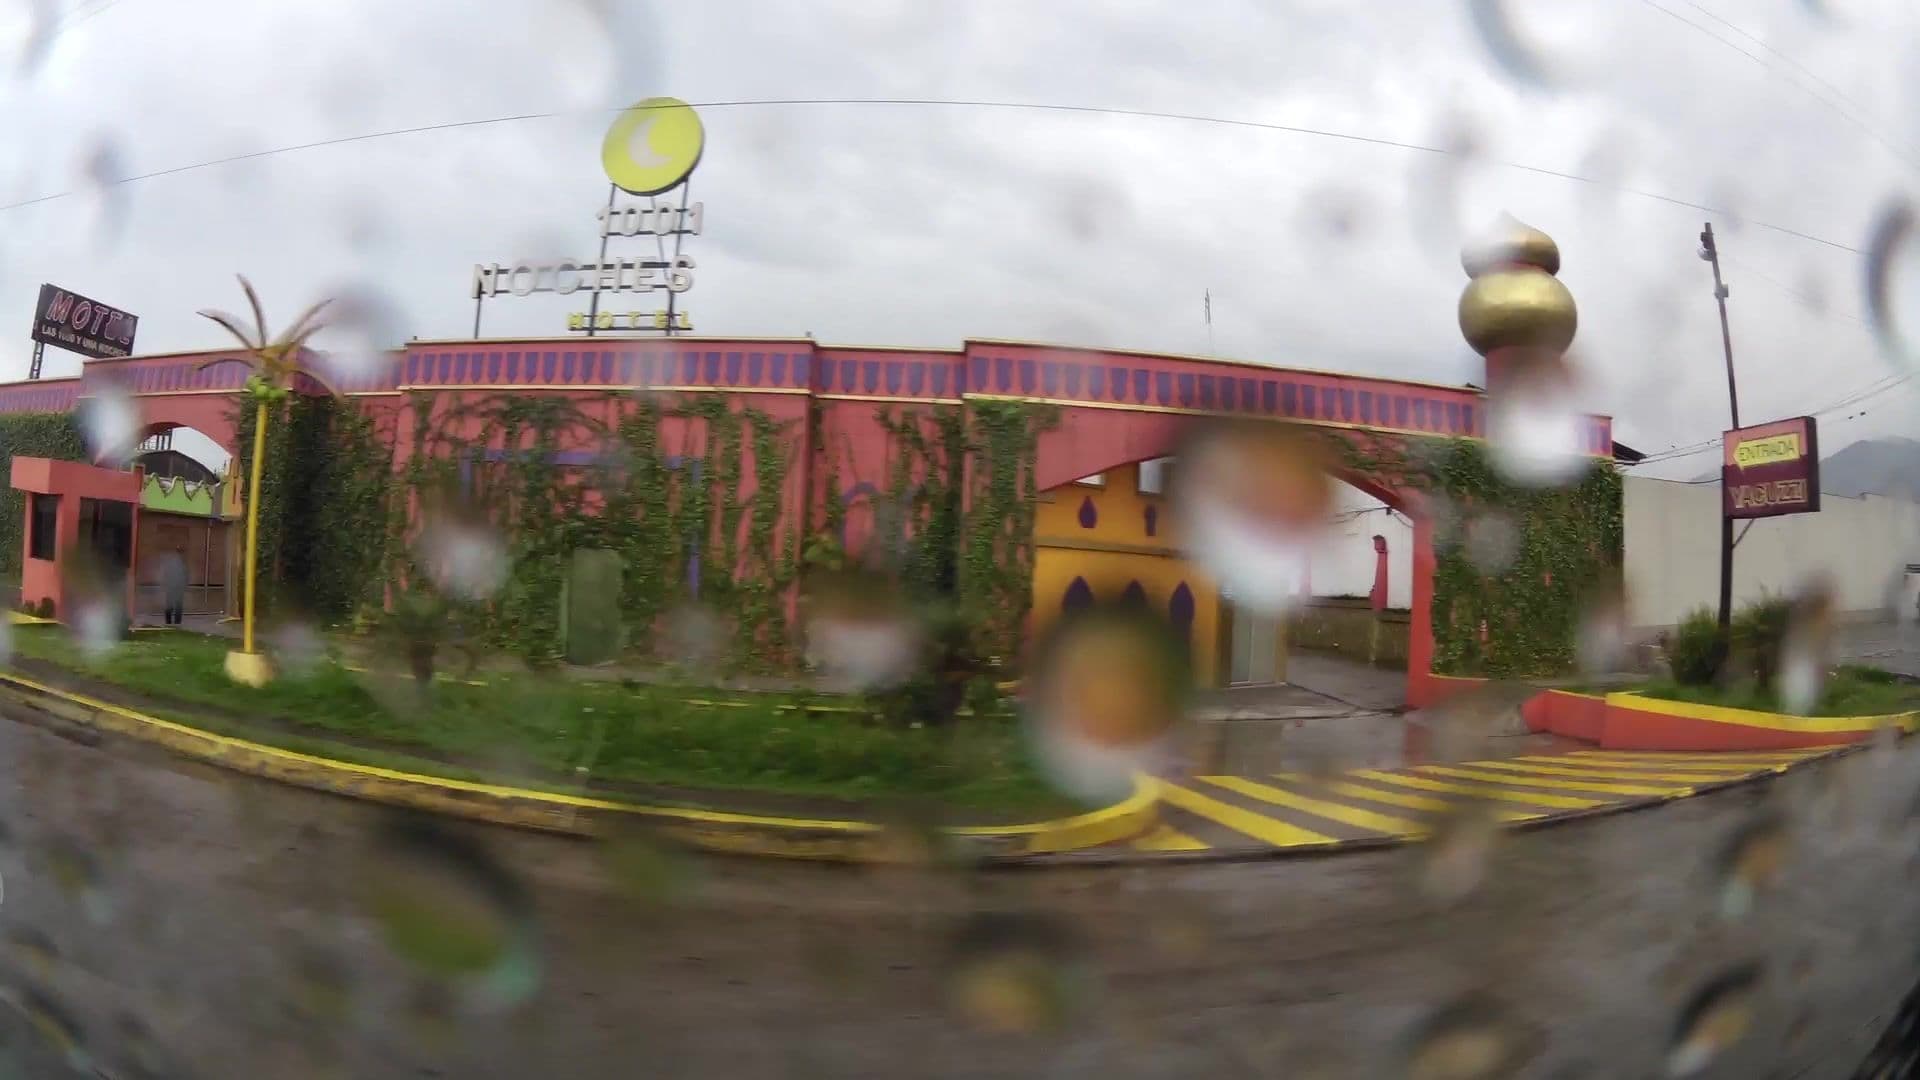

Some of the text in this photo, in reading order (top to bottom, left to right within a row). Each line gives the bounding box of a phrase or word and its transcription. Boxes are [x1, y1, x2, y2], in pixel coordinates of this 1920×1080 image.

[596, 202, 704, 238] 1001
[472, 255, 696, 298] NOCHES
[1738, 439, 1795, 462] ENTRADA
